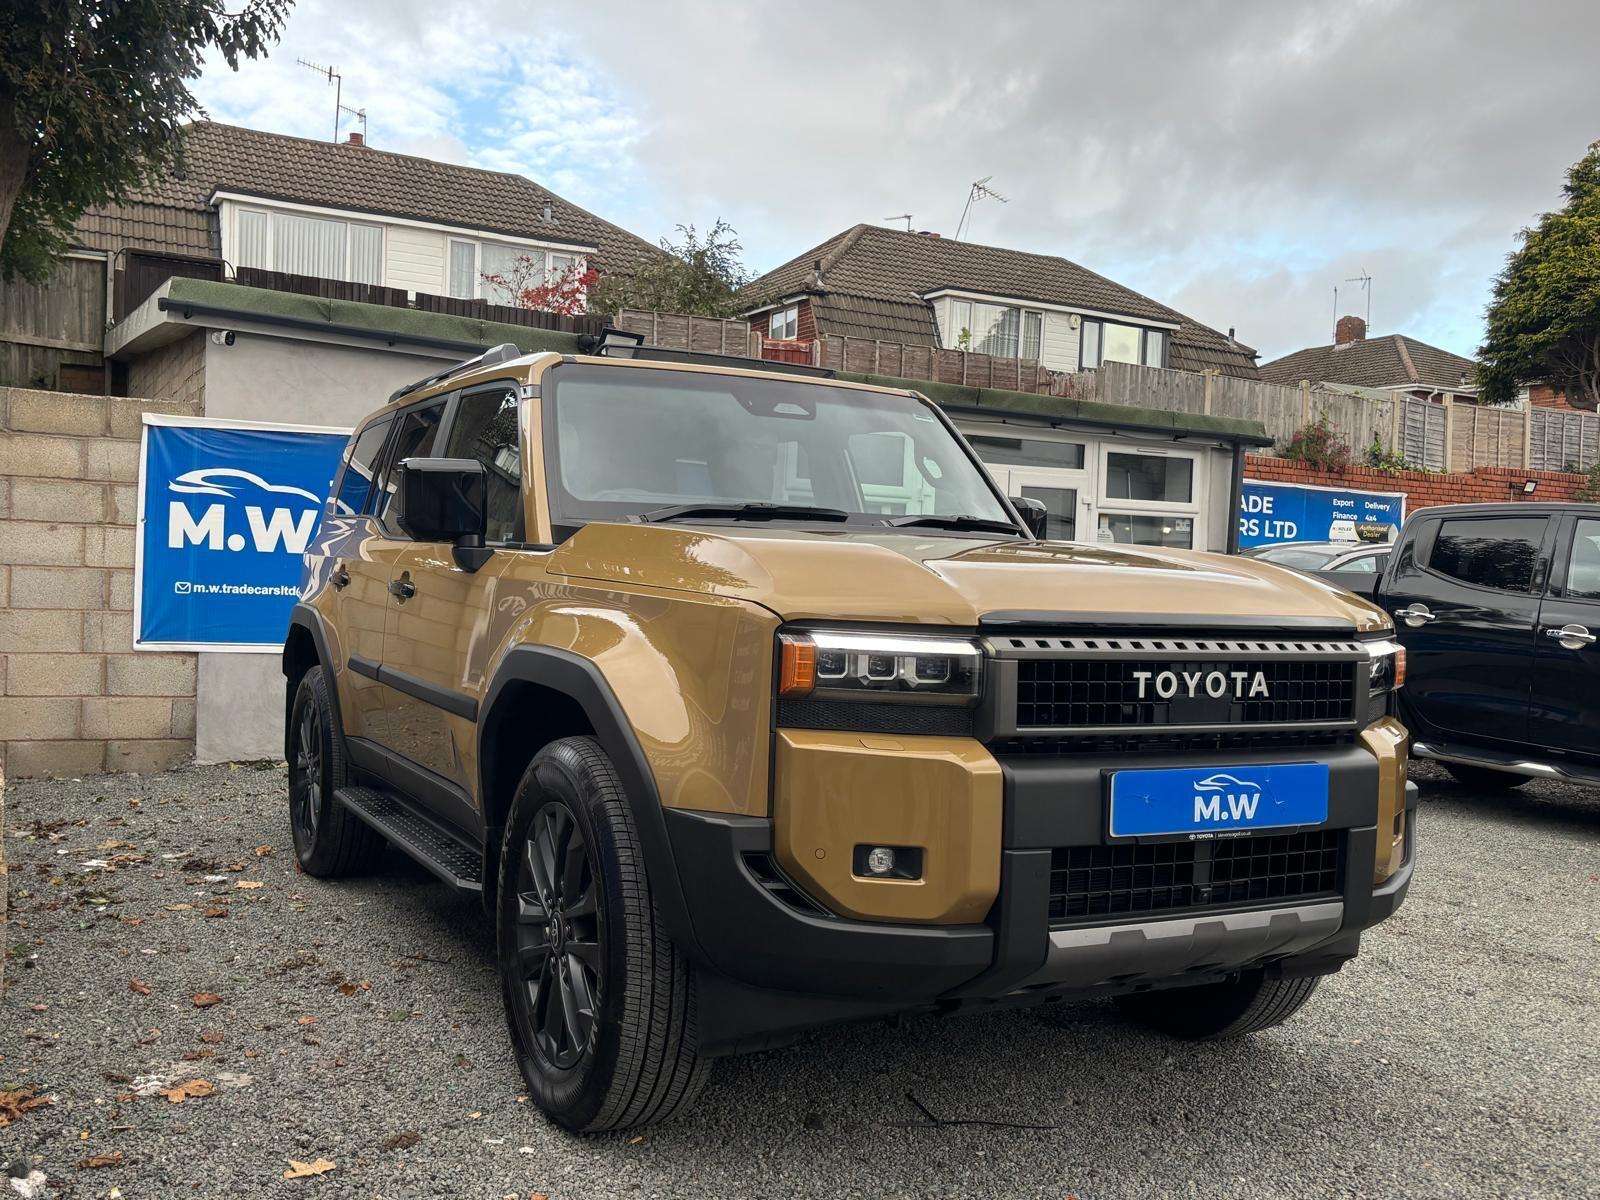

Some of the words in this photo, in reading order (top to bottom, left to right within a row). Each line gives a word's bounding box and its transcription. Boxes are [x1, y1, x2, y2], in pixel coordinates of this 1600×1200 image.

[1333, 498, 1354, 508] Export
[1364, 501, 1391, 512] Delivery
[1332, 511, 1358, 521] Finance
[1365, 514, 1377, 522] 4x4
[168, 501, 318, 554] M.W
[1264, 519, 1298, 539] LTD
[1133, 670, 1270, 699] TOYOTA
[1194, 793, 1260, 822] M.W
